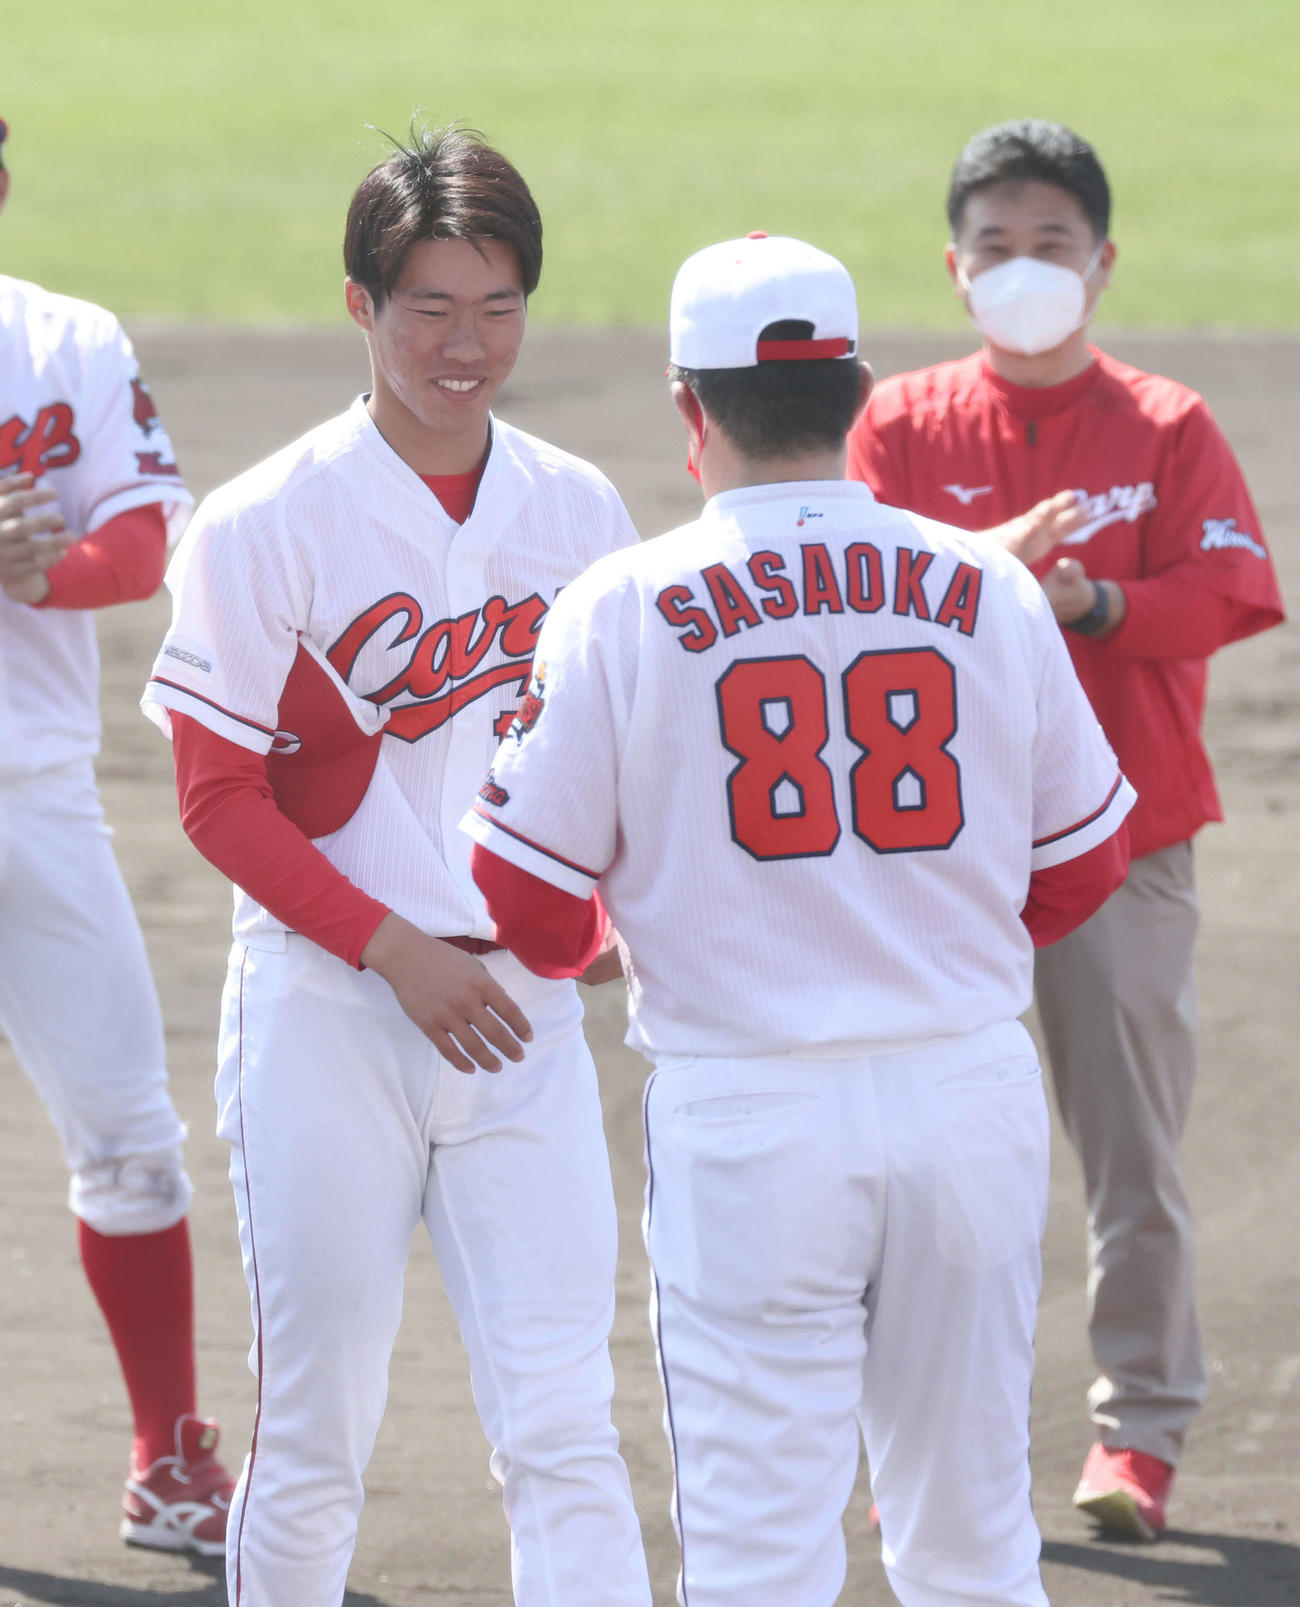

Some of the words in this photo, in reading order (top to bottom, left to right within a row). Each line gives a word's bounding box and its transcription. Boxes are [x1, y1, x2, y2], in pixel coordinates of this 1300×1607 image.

[1066, 482, 1158, 543] arp
[655, 541, 983, 654] SASAOKA
[326, 589, 560, 743] Car
[715, 646, 965, 861] 88
